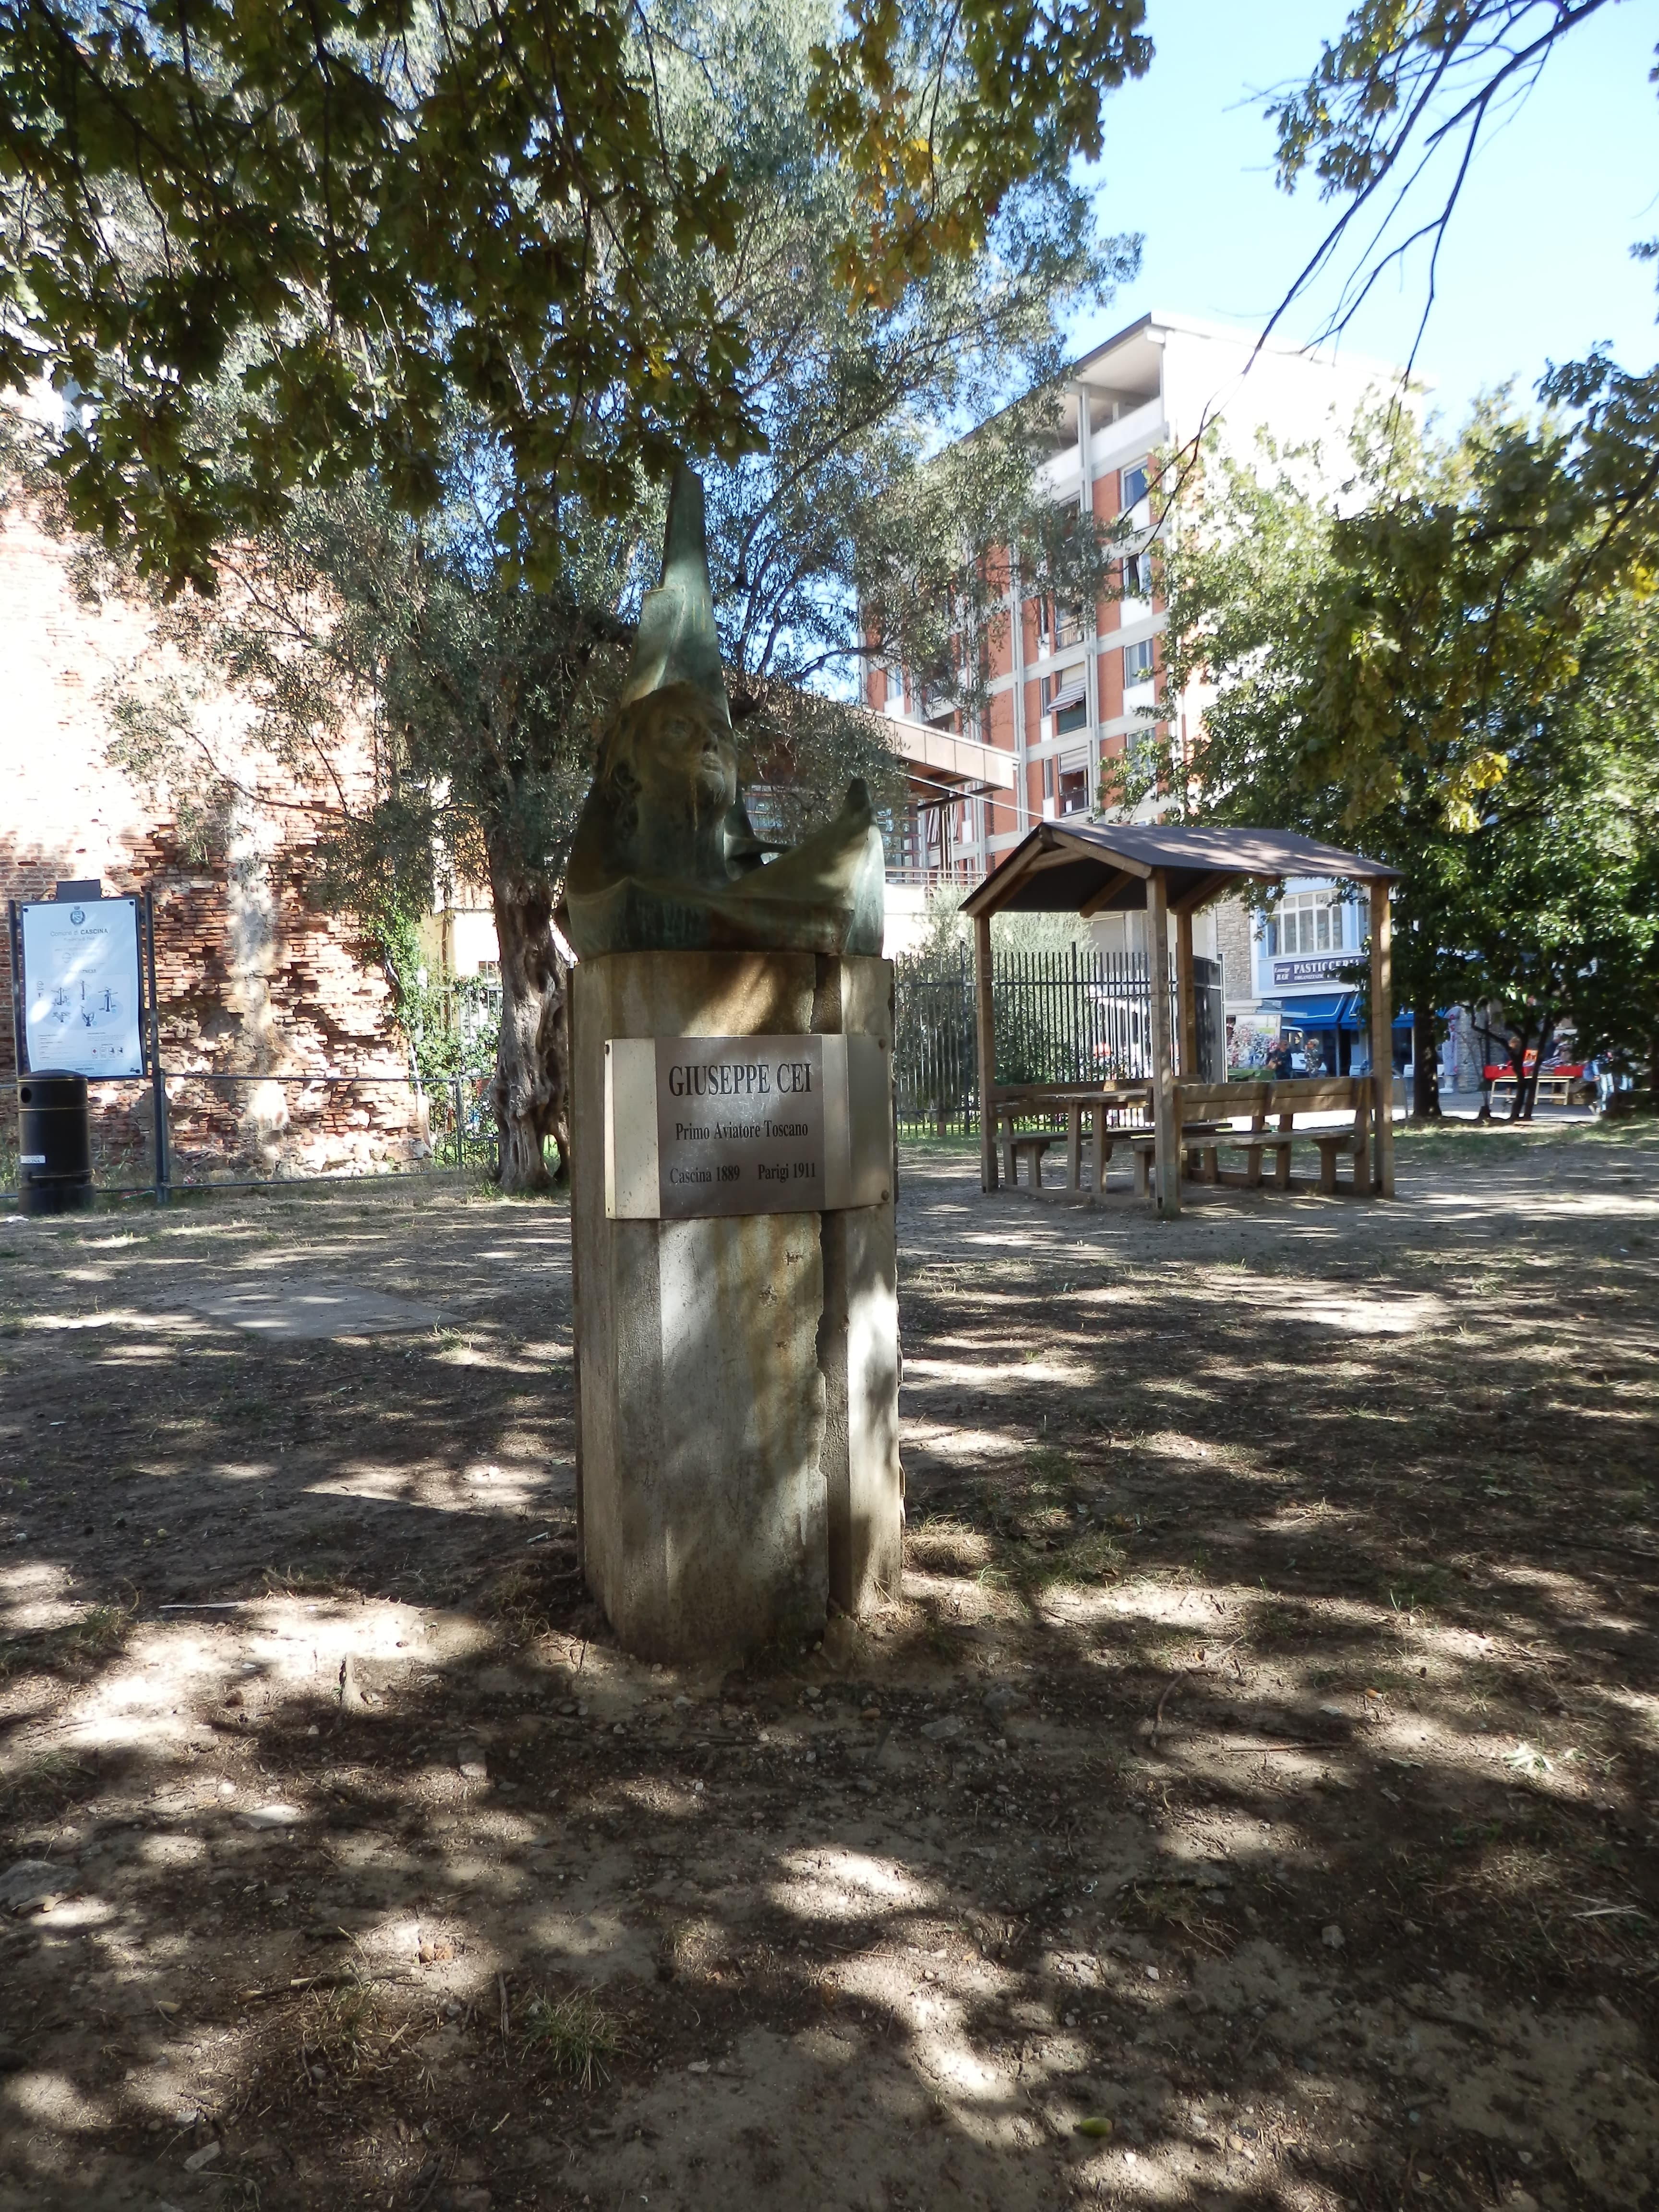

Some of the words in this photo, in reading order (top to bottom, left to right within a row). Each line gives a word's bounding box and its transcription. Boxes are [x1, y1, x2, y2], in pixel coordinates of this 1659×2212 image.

[669, 1064, 770, 1096] GIUSEPPE
[777, 1063, 812, 1093] CEI
[675, 1123, 709, 1141] Primo
[714, 1121, 761, 1139] Aviatore
[764, 1120, 808, 1137] Toscano
[670, 1167, 712, 1184] Cascina
[716, 1165, 740, 1182] 1889
[757, 1163, 789, 1183] Parigi
[793, 1162, 816, 1178] 1911
